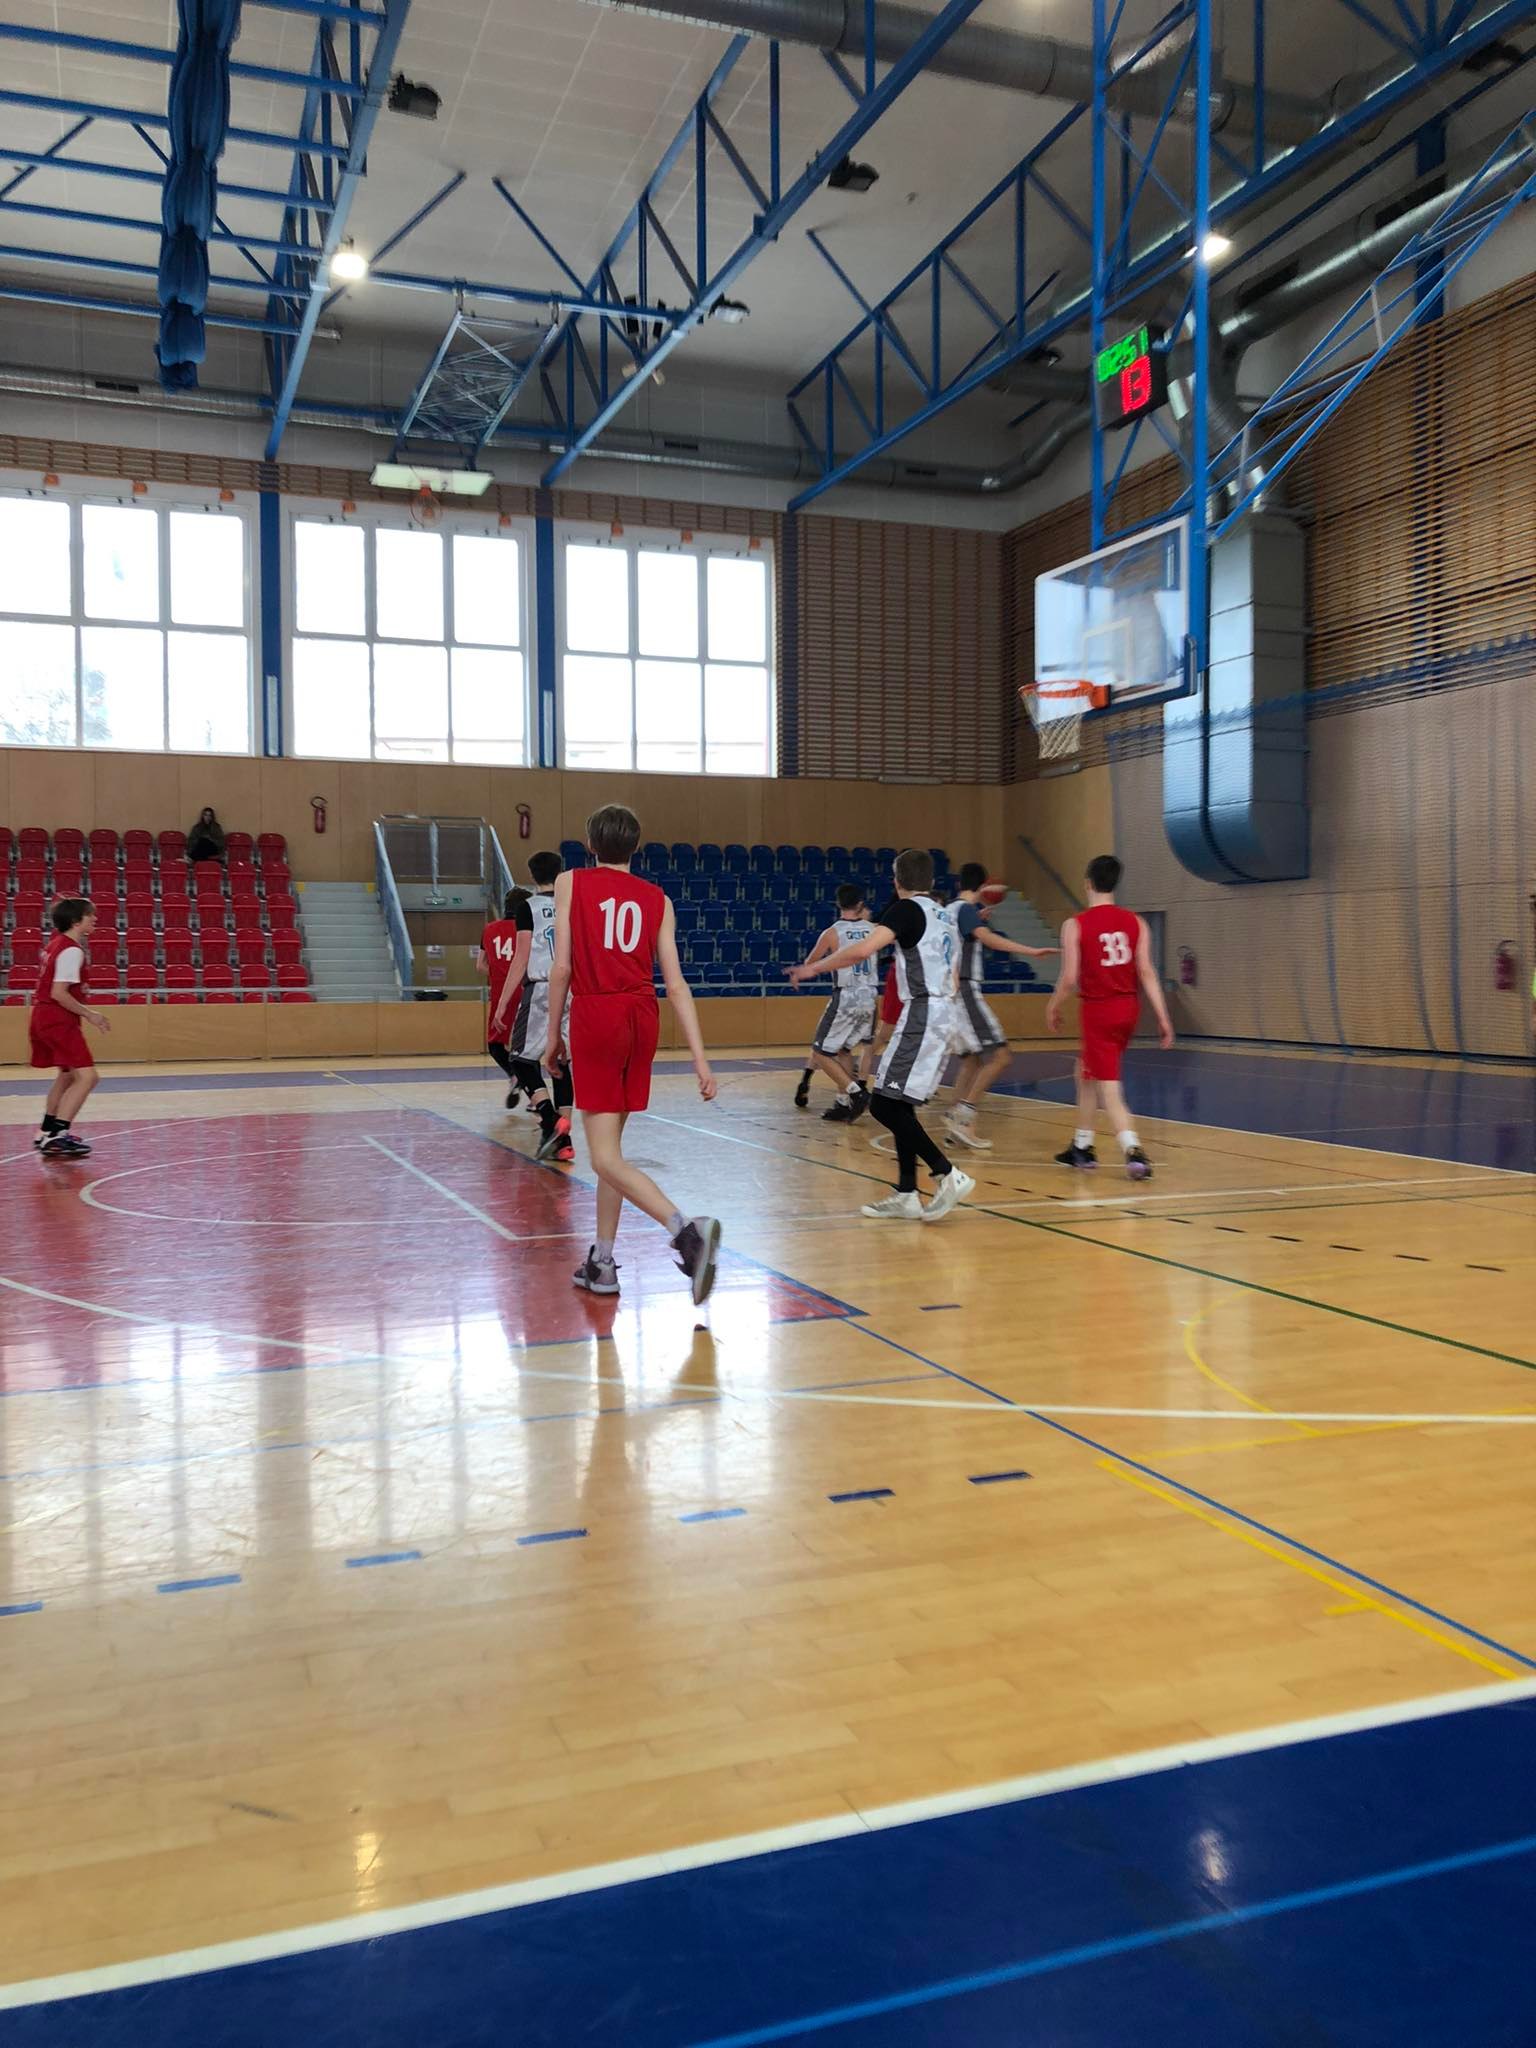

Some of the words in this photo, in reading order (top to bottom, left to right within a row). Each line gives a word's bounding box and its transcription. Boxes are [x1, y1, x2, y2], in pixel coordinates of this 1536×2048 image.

[599, 897, 643, 954] 10
[492, 935, 515, 962] 14
[1098, 931, 1133, 967] 33
